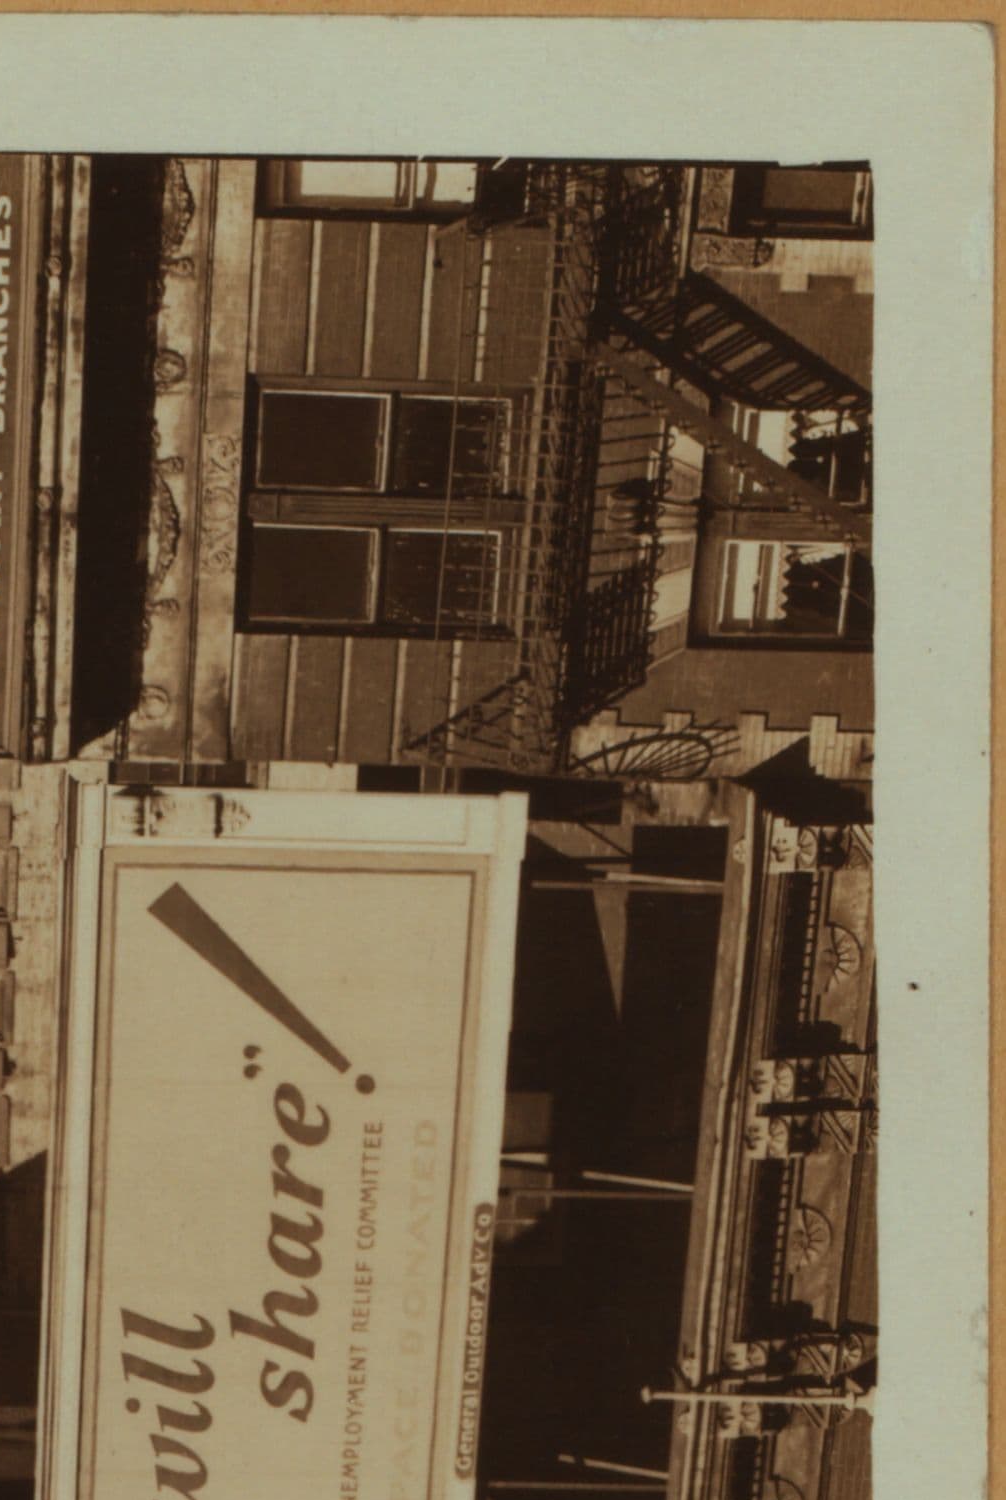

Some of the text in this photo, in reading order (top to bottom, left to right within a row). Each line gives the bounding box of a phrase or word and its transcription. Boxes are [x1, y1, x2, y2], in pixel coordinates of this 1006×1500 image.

[356, 1120, 383, 1250] COMMITTEE
[398, 1119, 438, 1356] DONATED
[476, 1213, 493, 1242] Co
[351, 1260, 374, 1332] RELIEF
[464, 1297, 486, 1383] Outdoor
[456, 1389, 479, 1470] General
